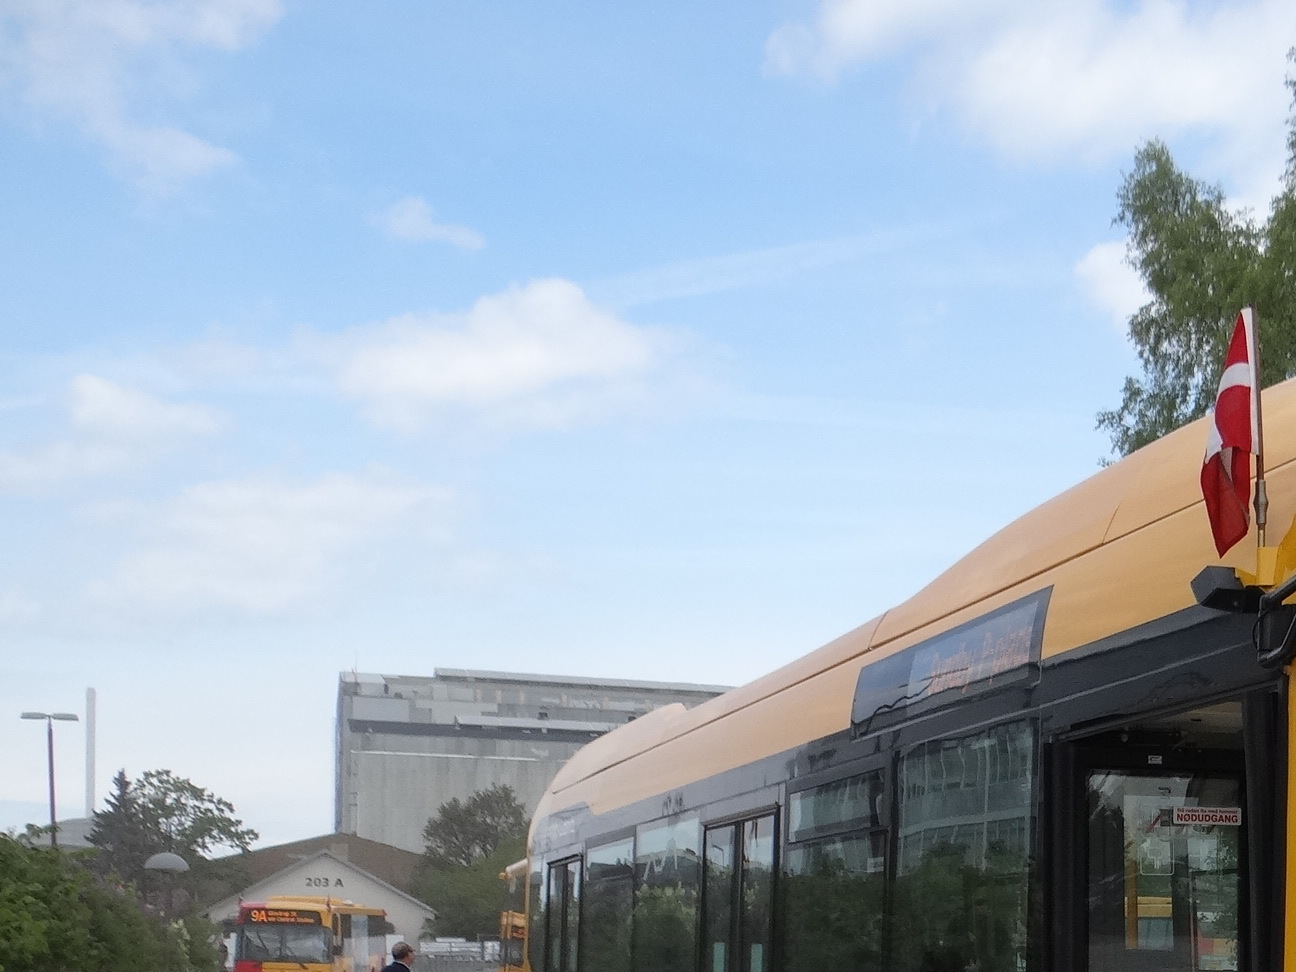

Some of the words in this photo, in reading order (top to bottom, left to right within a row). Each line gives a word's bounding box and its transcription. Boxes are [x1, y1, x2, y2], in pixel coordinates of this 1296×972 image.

[1177, 813, 1238, 823] NØDUDGANG
[305, 878, 329, 887] 203
[334, 878, 344, 887] A
[250, 909, 267, 922] 9A
